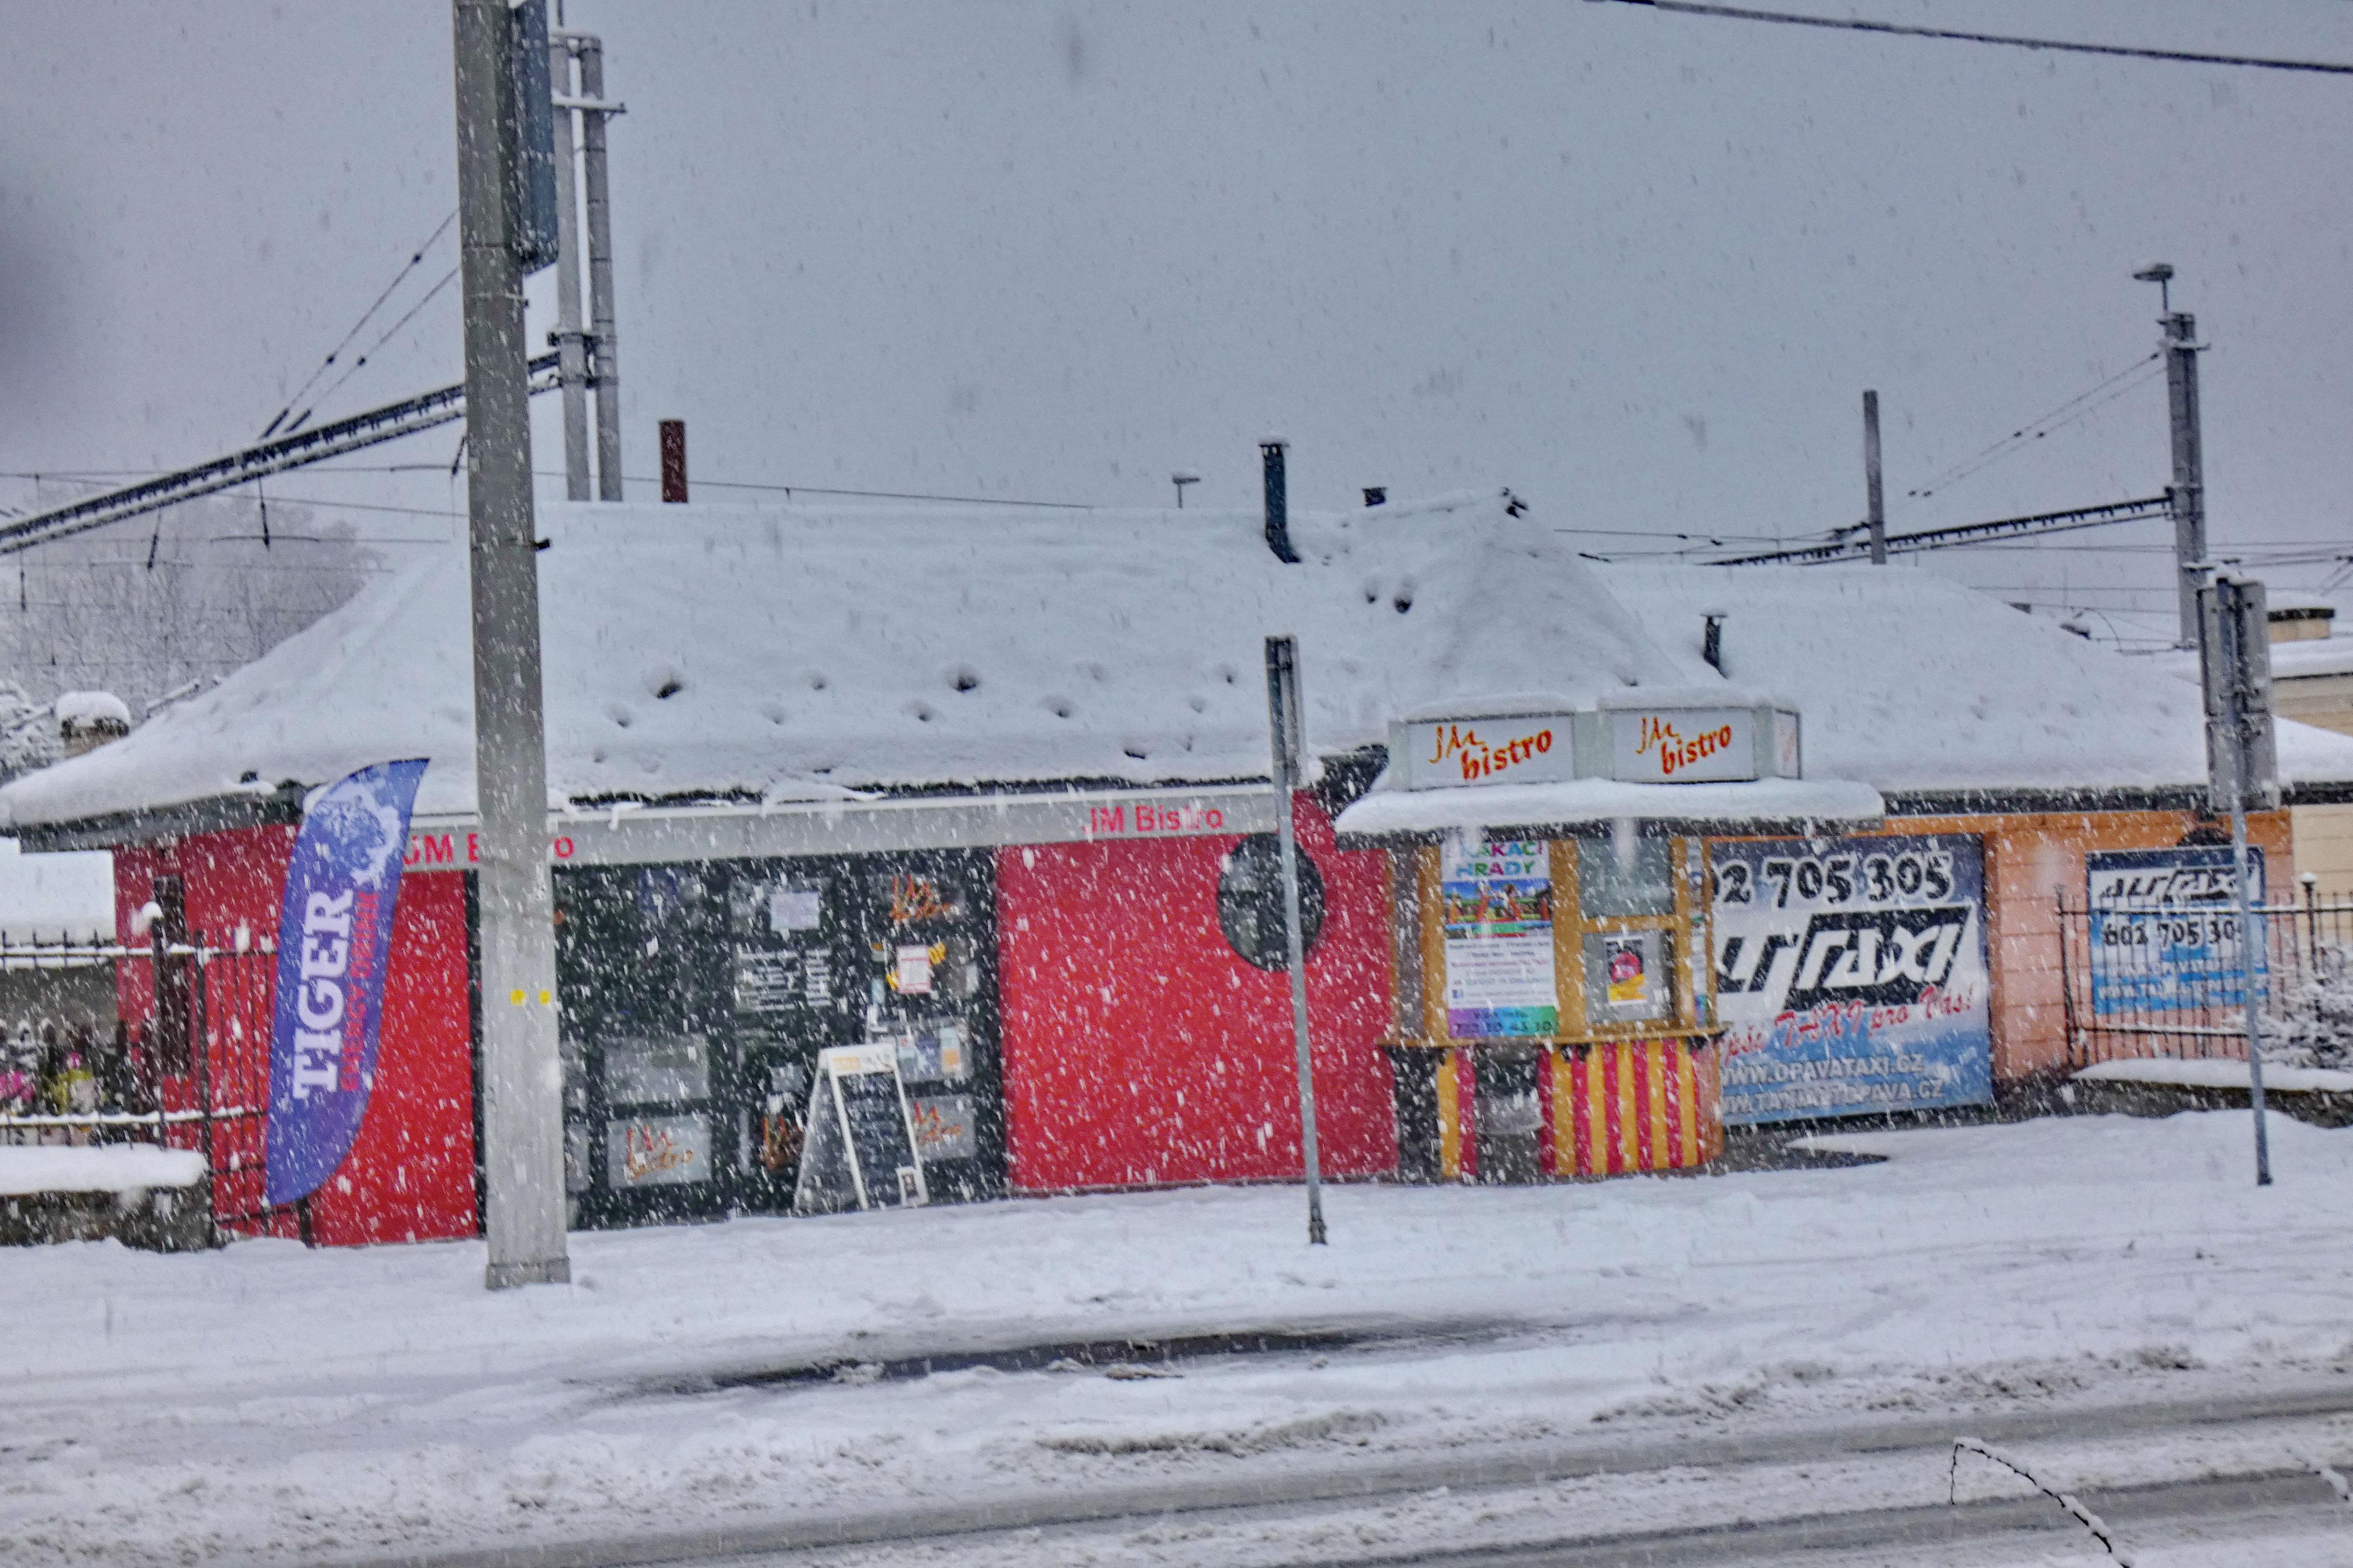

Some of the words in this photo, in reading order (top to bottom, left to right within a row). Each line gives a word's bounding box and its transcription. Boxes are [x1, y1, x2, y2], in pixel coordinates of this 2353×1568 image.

[1460, 729, 1552, 781] bistro
[1660, 724, 1732, 775] bistro
[1135, 804, 1224, 832] Bistro
[1766, 858, 1853, 909] 705
[1866, 852, 1951, 900] 305
[2157, 919, 2199, 947] 705
[292, 888, 354, 1100] TIGER
[1867, 1004, 1909, 1039] pro
